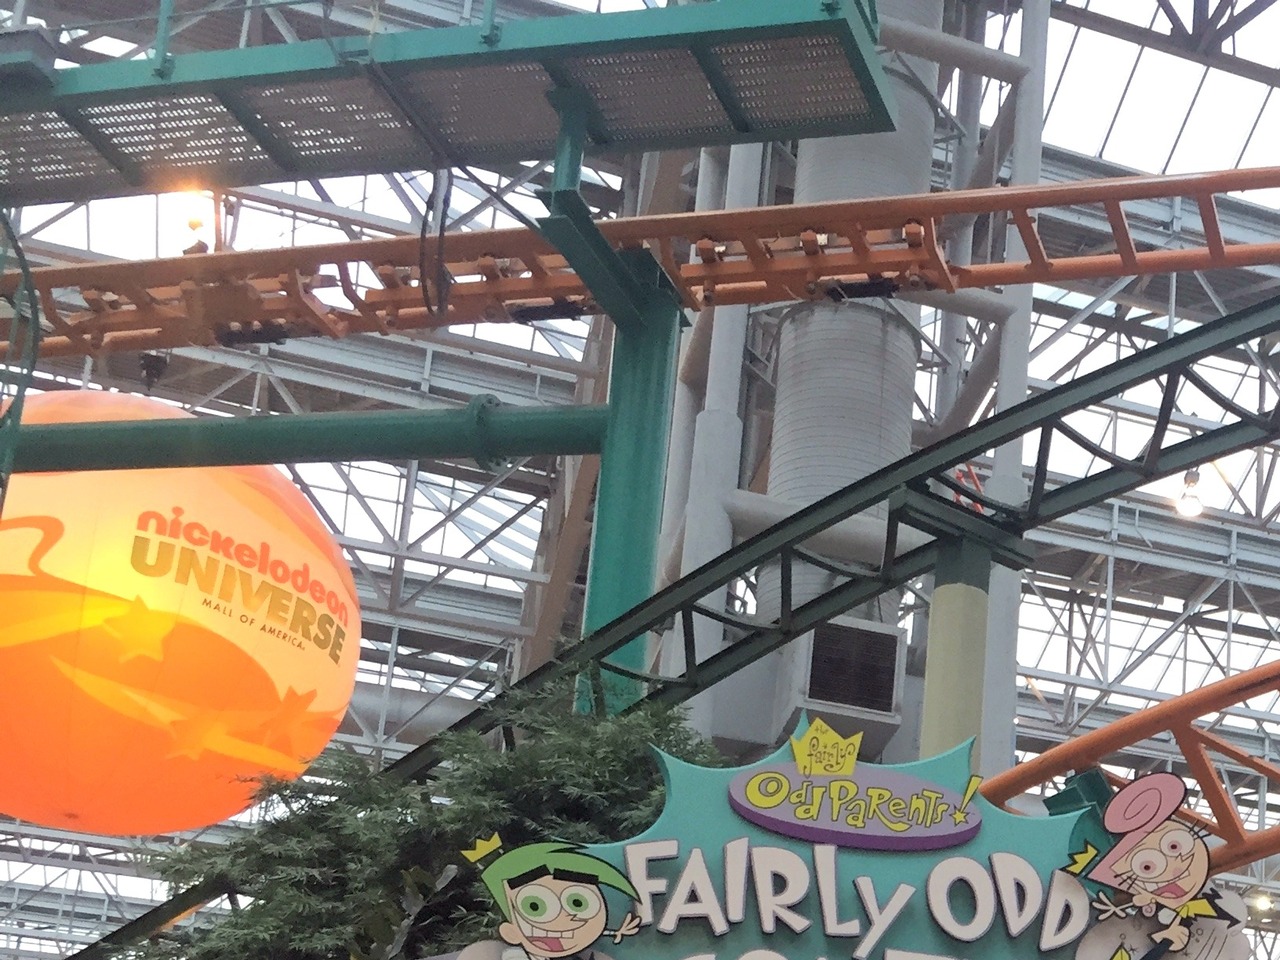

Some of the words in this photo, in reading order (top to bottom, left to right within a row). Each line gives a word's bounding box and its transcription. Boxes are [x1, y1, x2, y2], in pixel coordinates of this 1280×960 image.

[130, 535, 346, 665] UNIVERSE
[136, 506, 348, 627] nickelodeon
[202, 598, 233, 618] MALL
[239, 613, 256, 627] OF
[624, 837, 916, 960] FAIRLY
[926, 851, 1090, 952] ODD
